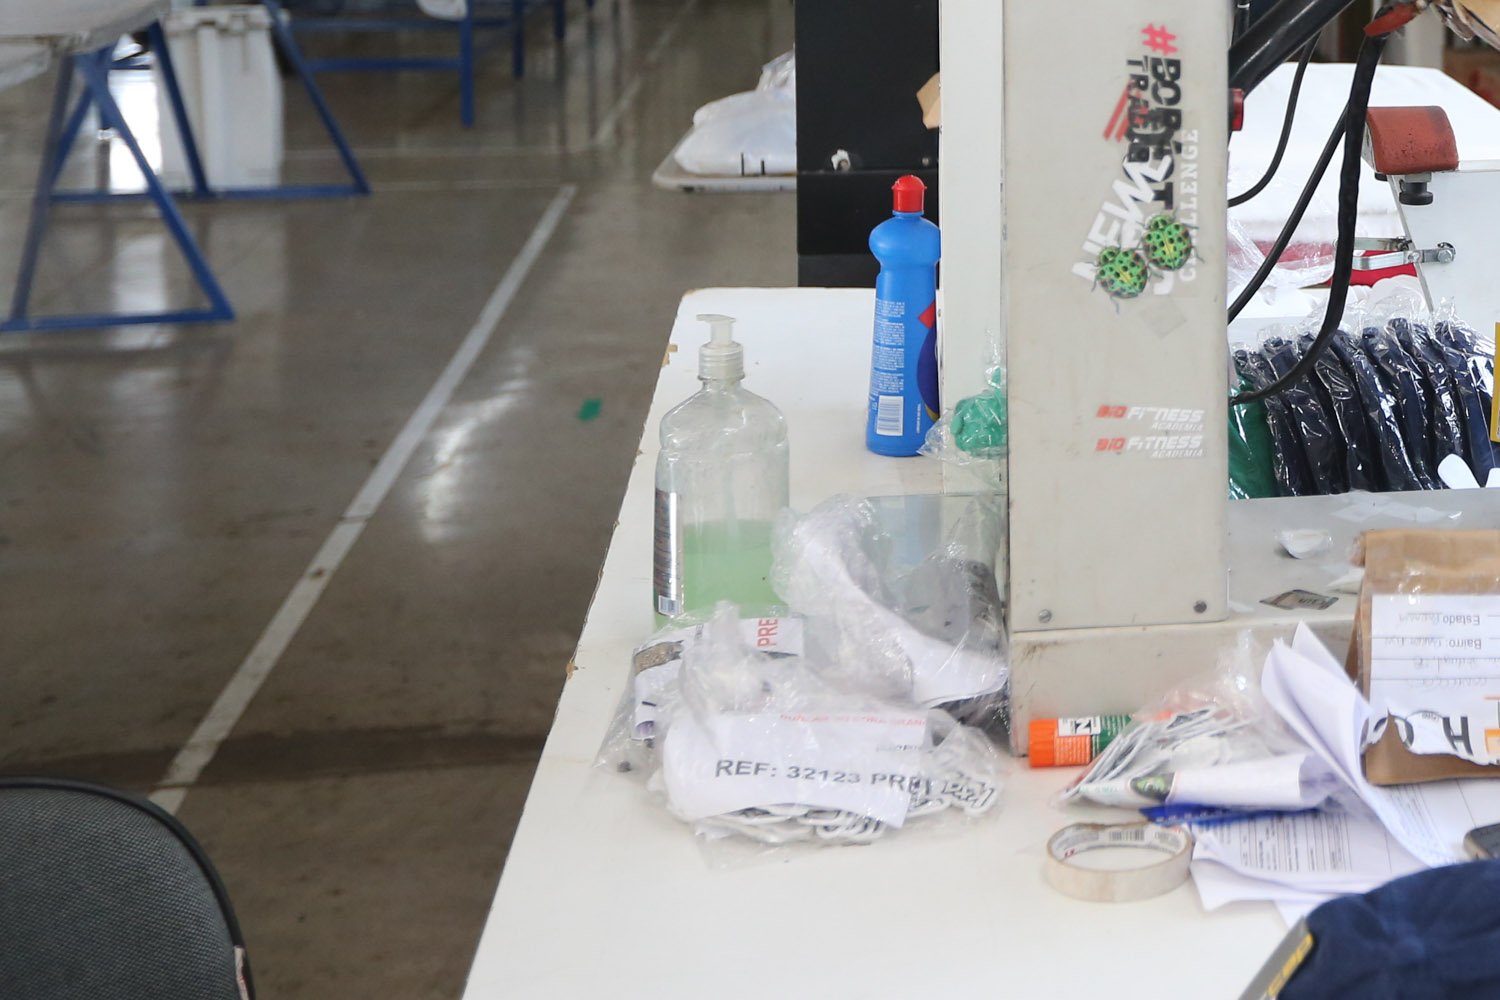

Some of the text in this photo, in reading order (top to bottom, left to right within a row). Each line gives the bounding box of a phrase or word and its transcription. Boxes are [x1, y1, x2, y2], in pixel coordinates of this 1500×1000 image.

[1180, 128, 1199, 283] CLLENGE
[715, 759, 777, 779] REF:
[786, 764, 861, 785] 32123
